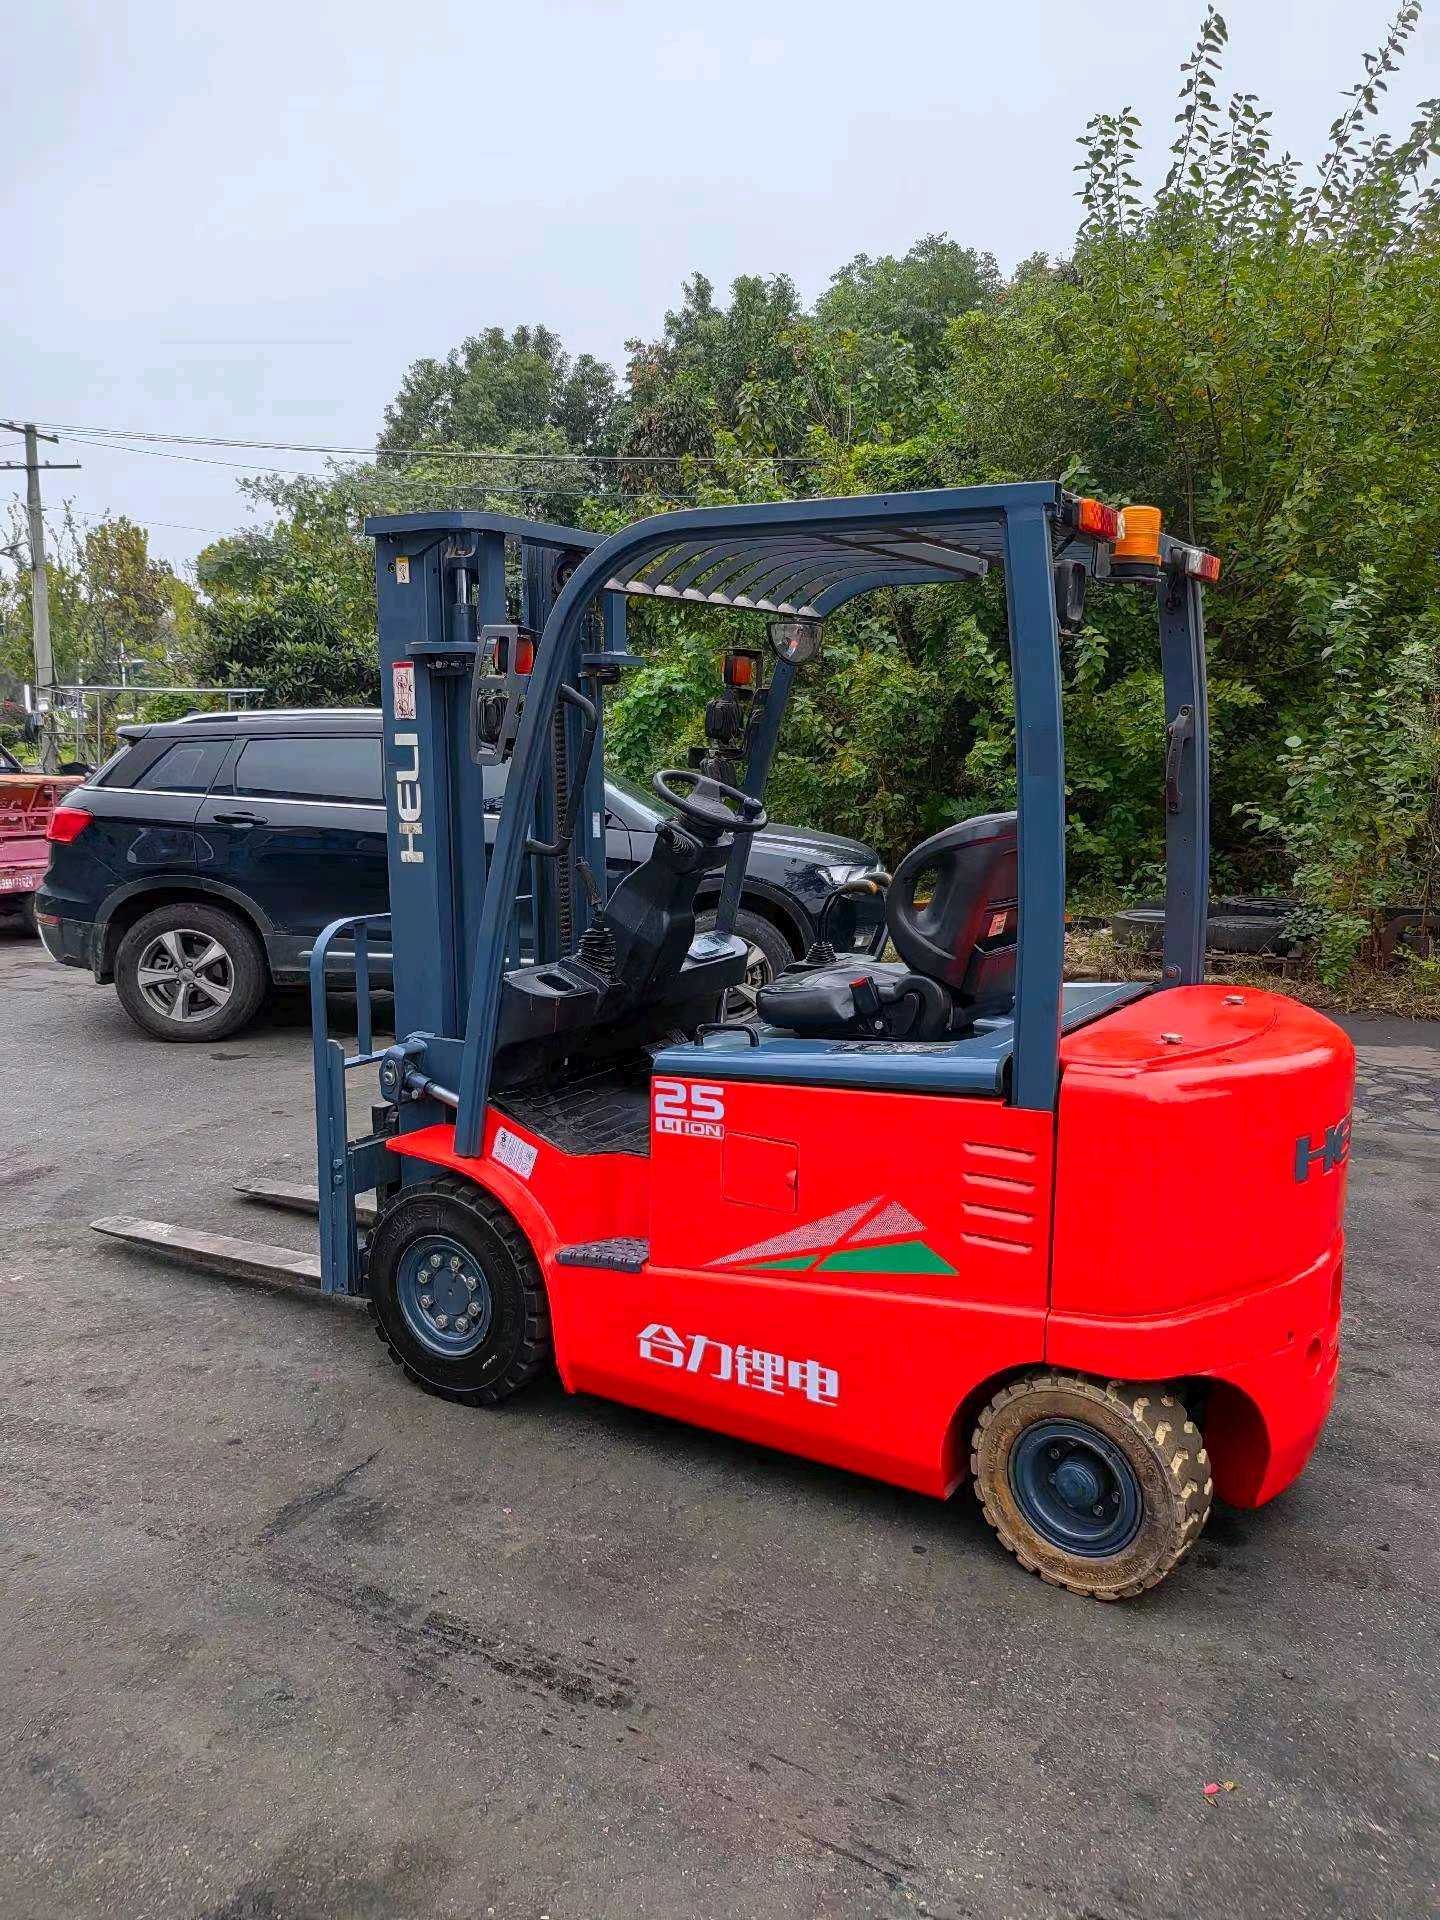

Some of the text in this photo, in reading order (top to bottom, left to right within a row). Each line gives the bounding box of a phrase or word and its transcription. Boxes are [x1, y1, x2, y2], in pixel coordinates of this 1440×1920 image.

[394, 732, 425, 863] HELI
[655, 1081, 725, 1120] 25
[637, 1323, 839, 1407] 合力锂电
